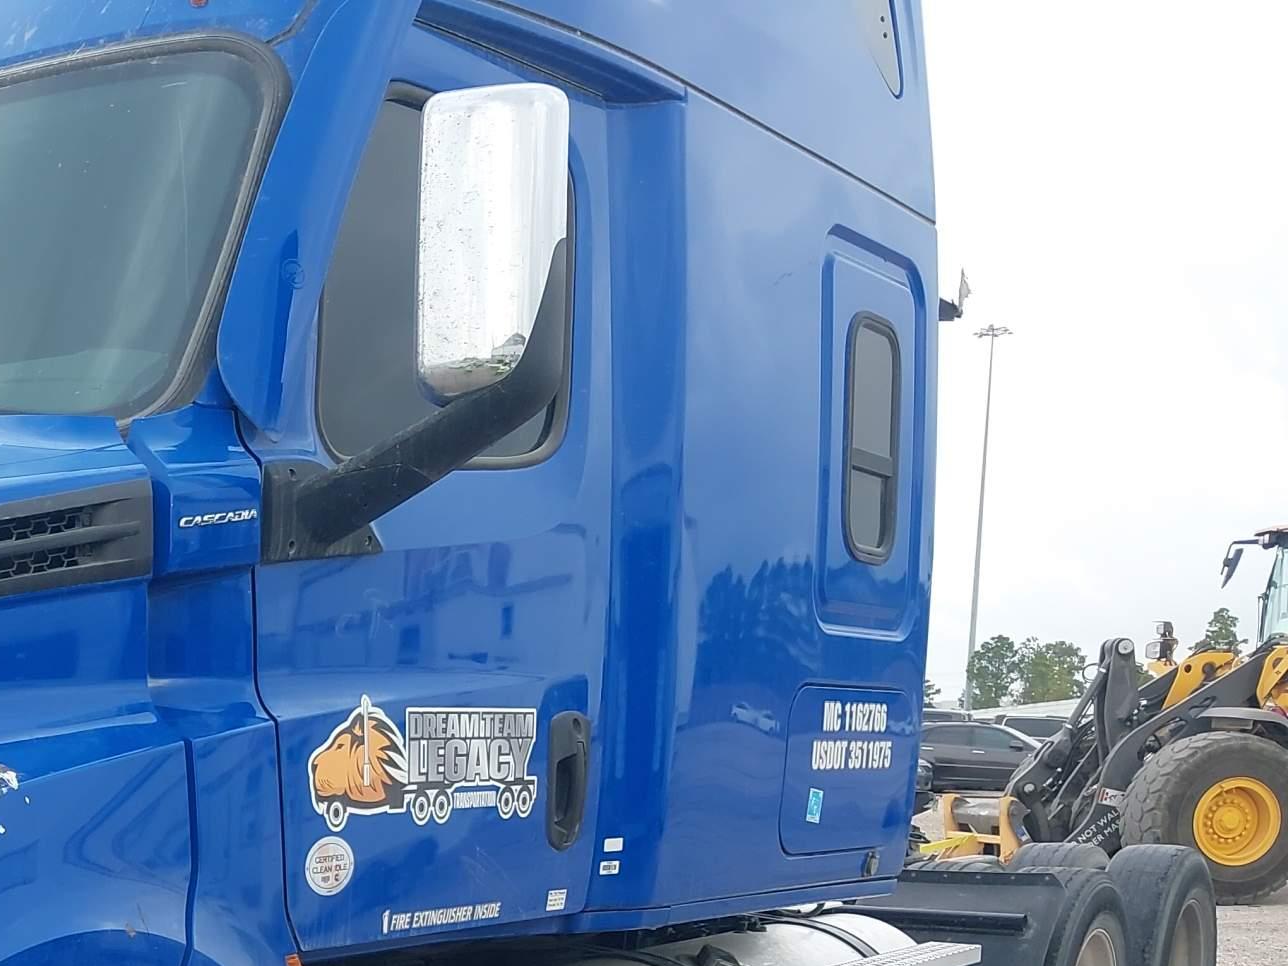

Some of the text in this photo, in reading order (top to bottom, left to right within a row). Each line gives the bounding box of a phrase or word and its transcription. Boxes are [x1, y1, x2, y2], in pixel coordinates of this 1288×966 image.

[179, 508, 258, 528] CASCADIA
[822, 700, 888, 733] MC 1162766
[408, 738, 533, 783] LEGACY
[811, 739, 893, 770] USDOT 3511975
[1077, 807, 1120, 844] NOT WAL
[312, 864, 333, 875] CLEAN
[314, 853, 345, 864] CERTIFIED
[390, 901, 502, 931] FIRE EXTINGUISHER INSIDE
